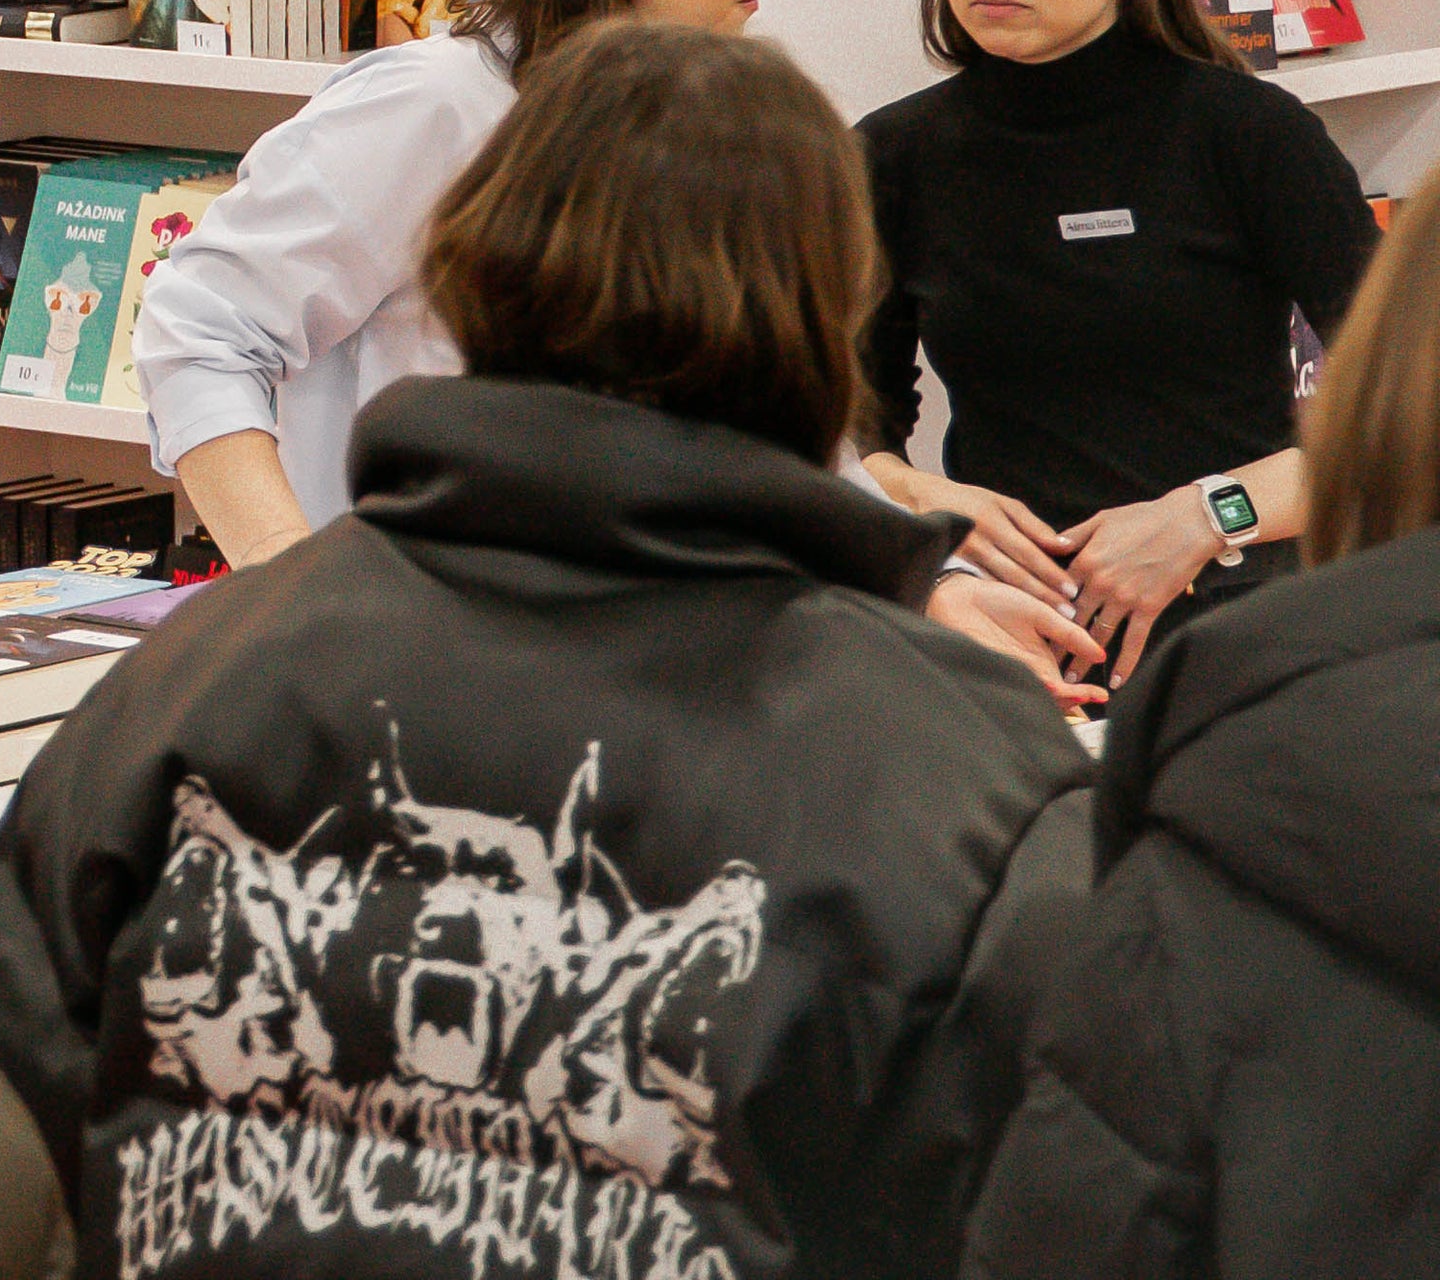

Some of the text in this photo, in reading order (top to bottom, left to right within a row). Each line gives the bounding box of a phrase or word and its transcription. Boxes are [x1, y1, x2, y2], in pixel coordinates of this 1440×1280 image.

[56, 199, 127, 223] PAŽADINK
[65, 224, 108, 244] MANE
[18, 366, 32, 380] 10
[80, 545, 154, 569] TOP
